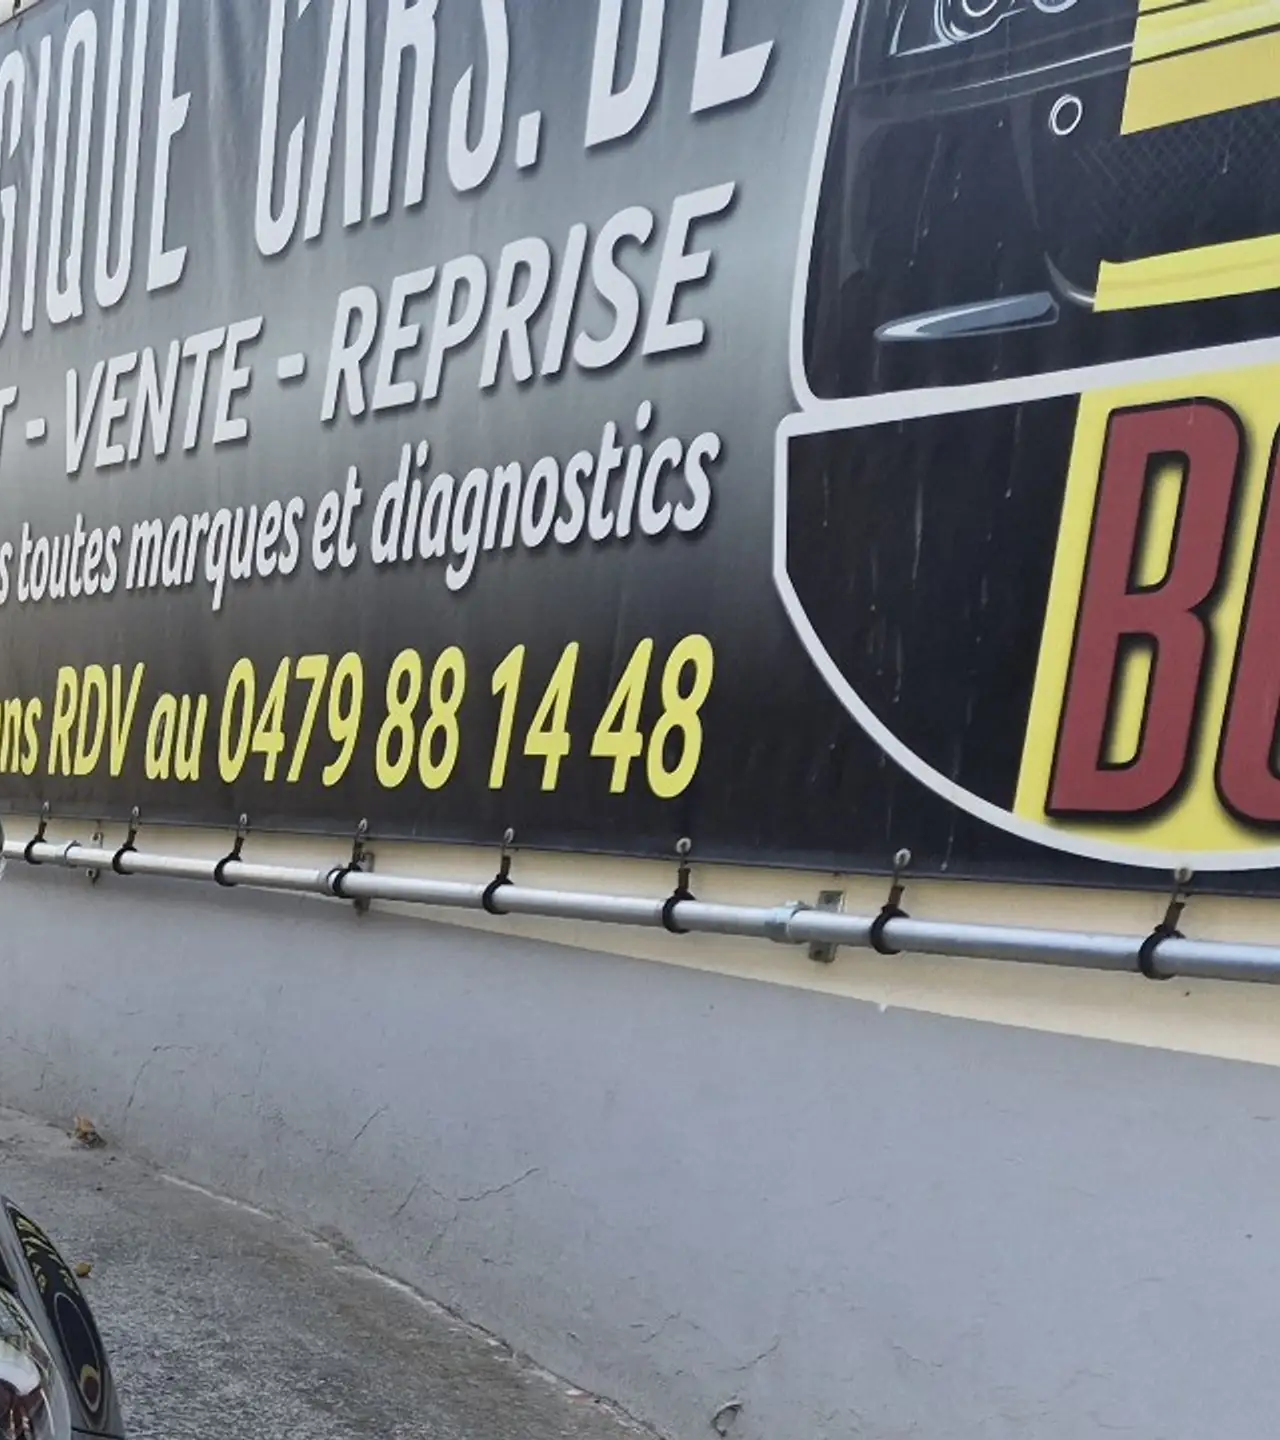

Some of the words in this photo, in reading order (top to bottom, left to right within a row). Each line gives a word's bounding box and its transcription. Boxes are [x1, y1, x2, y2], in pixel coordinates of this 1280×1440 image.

[65, 315, 263, 475] VENTE
[320, 180, 736, 423] REPRISE
[17, 513, 121, 604] toutes
[126, 496, 305, 612] marques
[311, 465, 362, 572] et
[371, 400, 722, 592] diagnostics
[47, 662, 145, 778] RDV
[145, 692, 209, 781] au
[217, 651, 364, 788] 0479
[375, 646, 466, 790] 88
[488, 640, 580, 792] 14
[591, 633, 715, 799] 48
